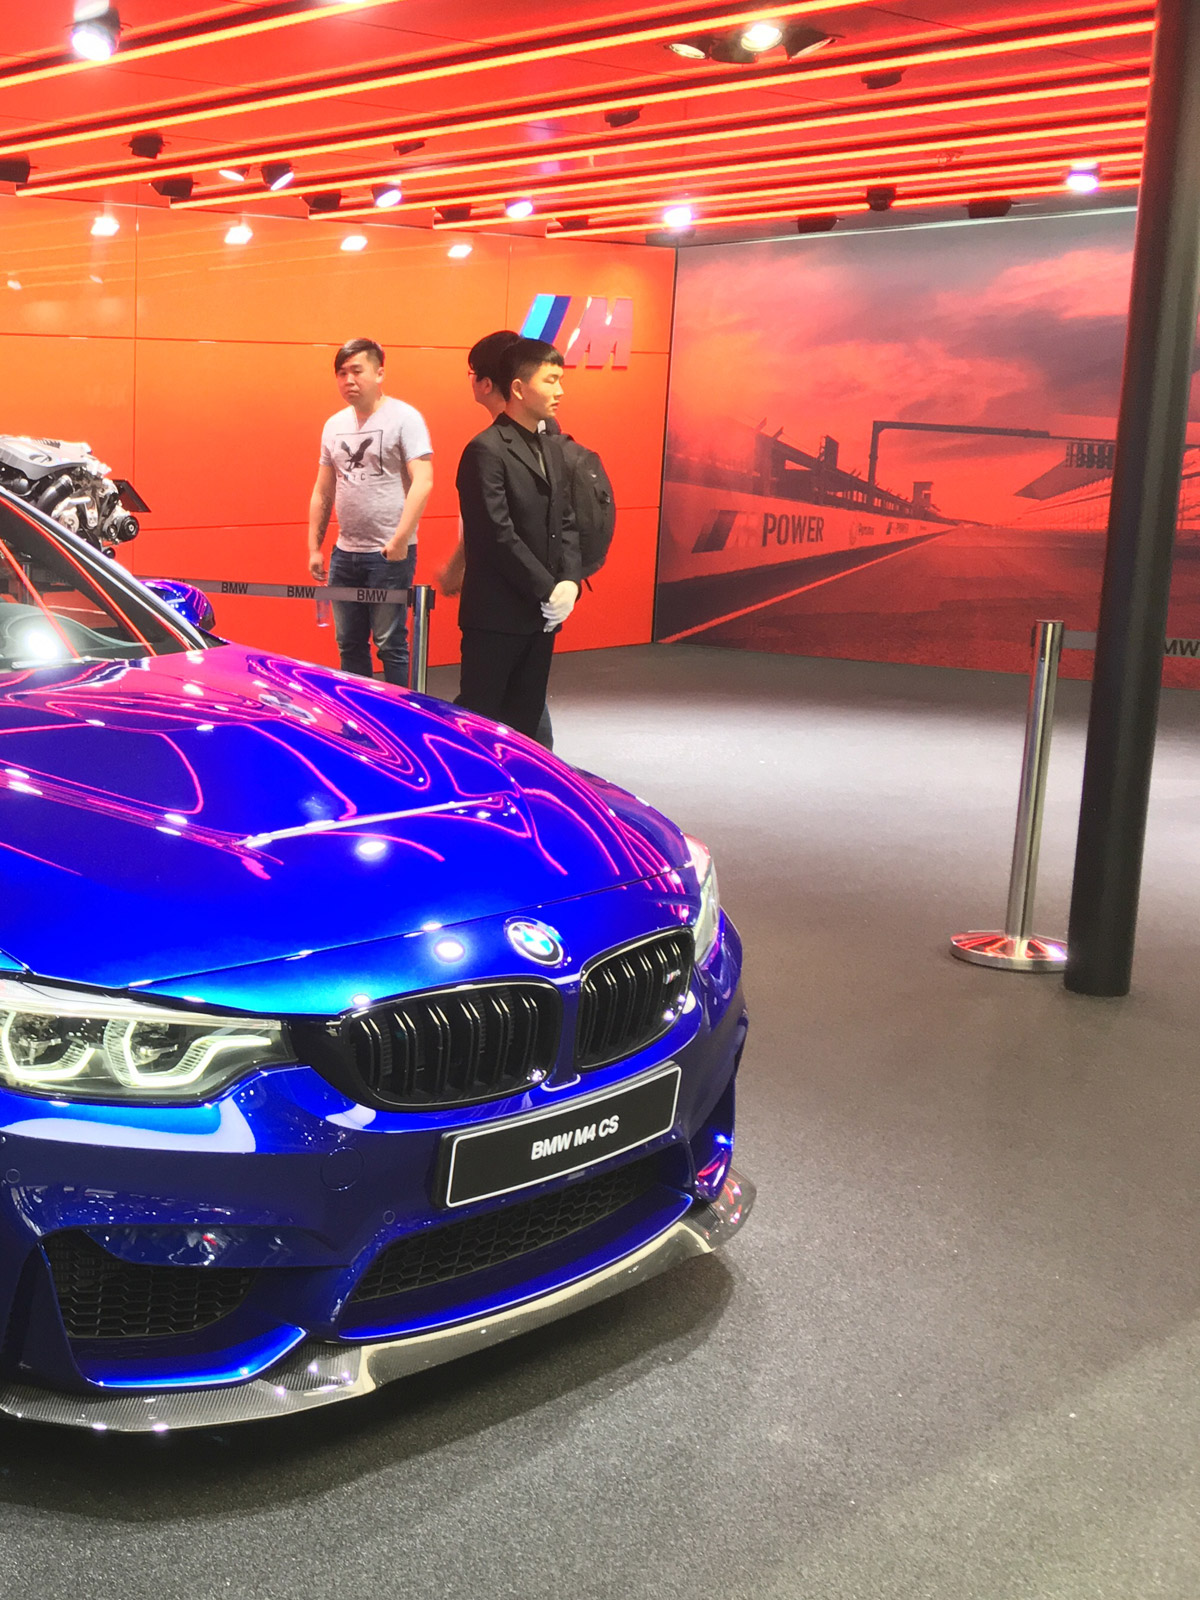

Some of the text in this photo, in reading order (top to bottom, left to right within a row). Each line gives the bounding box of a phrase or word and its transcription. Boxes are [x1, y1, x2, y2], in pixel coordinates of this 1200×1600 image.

[762, 512, 824, 547] POWER
[221, 582, 249, 595] BMW
[286, 586, 316, 599] BMW
[356, 590, 388, 603] BMW
[531, 1115, 619, 1161] BMW M4 CS
